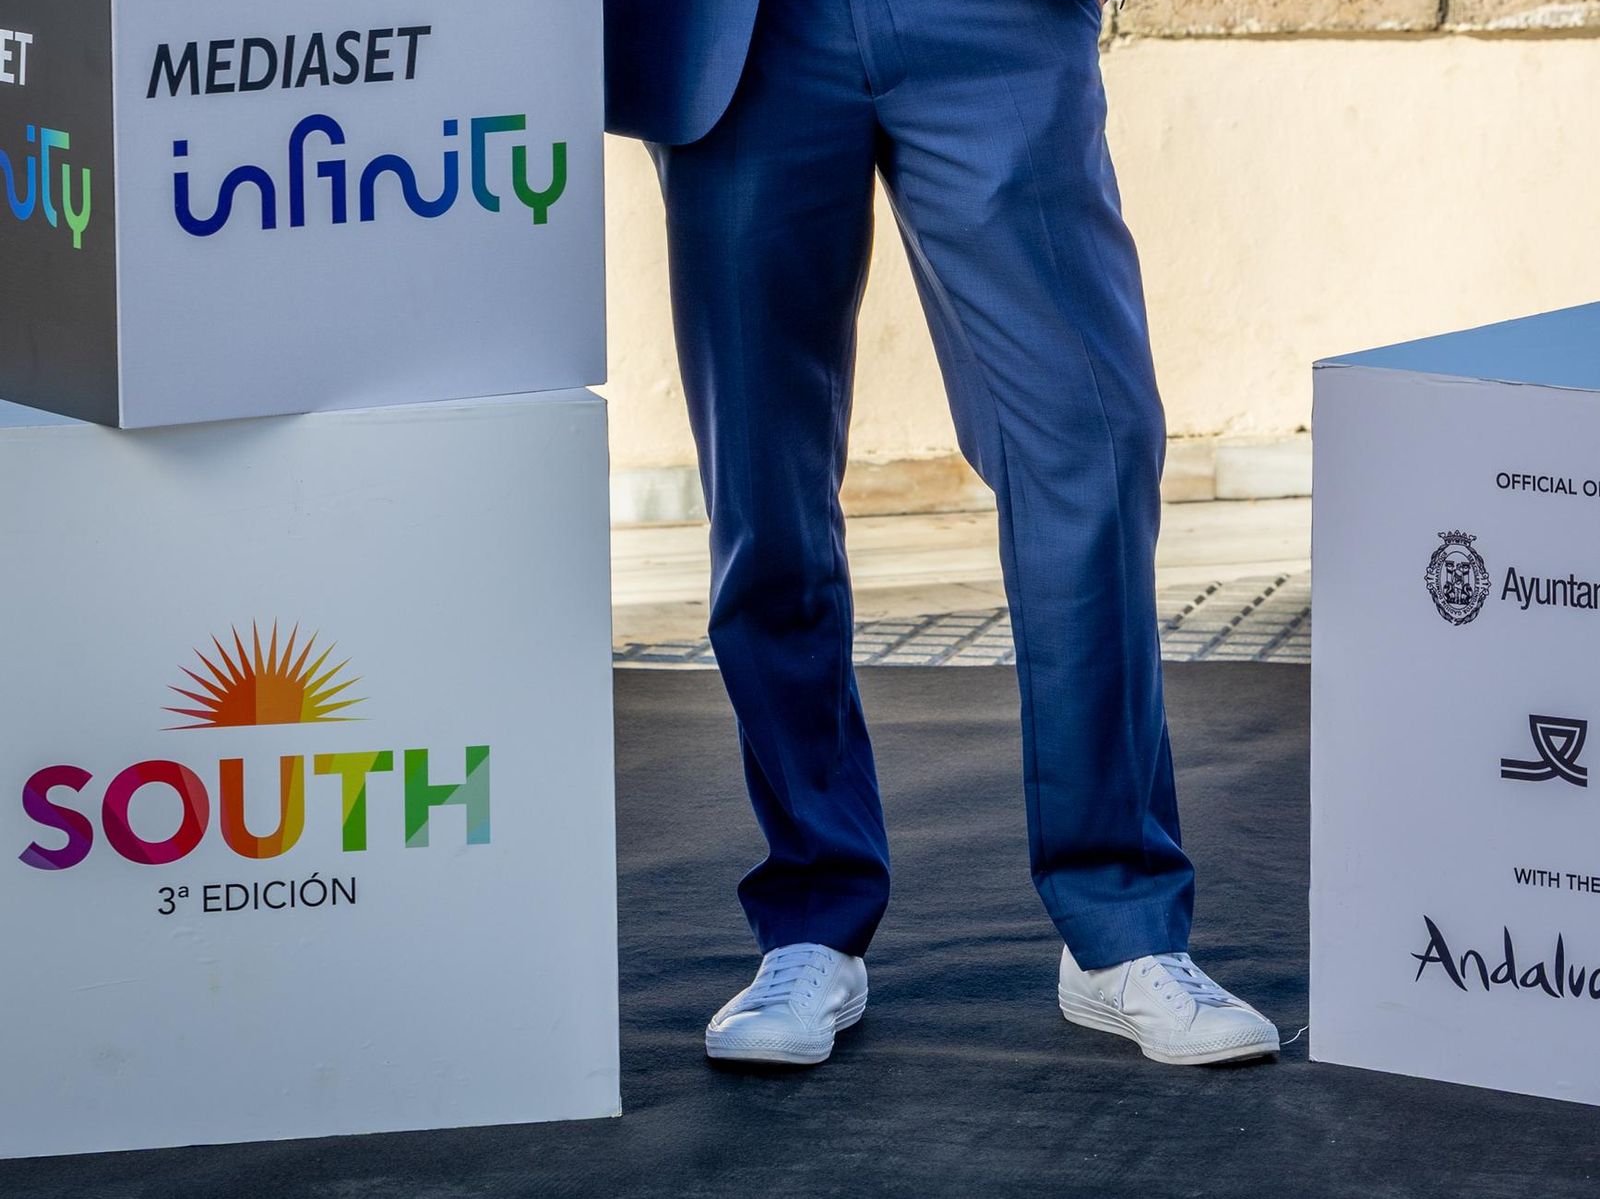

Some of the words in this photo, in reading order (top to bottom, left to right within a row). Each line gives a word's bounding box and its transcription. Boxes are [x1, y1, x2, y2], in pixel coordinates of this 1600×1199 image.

[146, 25, 432, 99] MEDIASET
[173, 113, 568, 237] infinity
[1496, 472, 1577, 495] OFFICIAL
[1583, 480, 1600, 497] O
[18, 745, 491, 871] SOUTH
[157, 886, 190, 915] 3ª
[202, 873, 357, 913] EDICIÓN
[1514, 867, 1560, 888] WITH
[1566, 874, 1600, 893] THE
